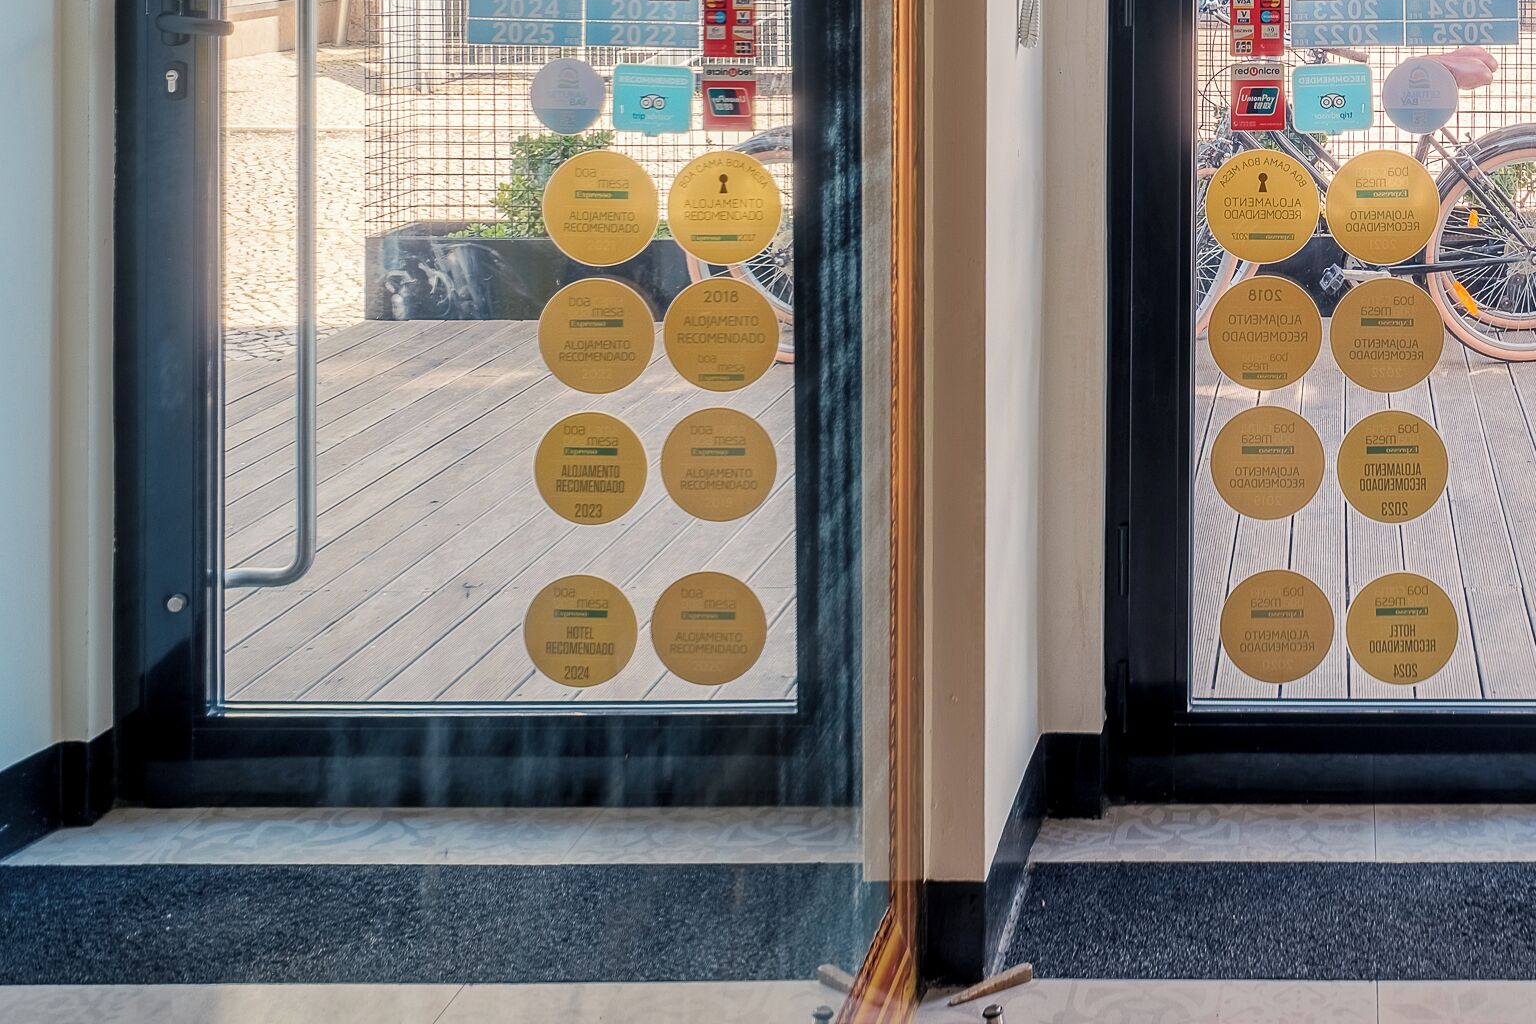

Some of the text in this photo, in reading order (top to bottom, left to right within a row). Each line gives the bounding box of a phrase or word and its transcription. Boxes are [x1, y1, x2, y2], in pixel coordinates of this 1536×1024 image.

[610, 0, 677, 20] 2023
[491, 21, 555, 44] 2025
[609, 25, 677, 45] 2022
[619, 75, 688, 85] RECOMMENDED
[1240, 94, 1276, 104] UnionPay
[684, 198, 763, 209] ALOJAMENTO
[568, 211, 635, 222] ALOJAMENTO
[684, 210, 763, 221] RECOMENDADO
[563, 223, 639, 233] RECOMENDADO
[703, 290, 739, 303] 2018
[683, 315, 758, 328] ALOJAMENTO
[677, 332, 766, 344] RECOMENDADO
[563, 339, 631, 351] ALOJAMENTO
[558, 351, 636, 362] RECOMENDADO
[560, 464, 620, 478] ALOJAMENTO
[685, 467, 752, 479] ALOJAMENTO
[555, 480, 625, 493] RECOMENDADO
[680, 479, 758, 491] RECOMENDADO
[574, 504, 603, 518] 2023
[566, 625, 594, 640] HOTEL
[674, 631, 743, 643] ALOJAMENTO
[545, 641, 615, 656] RECOMENDADO
[669, 643, 748, 655] RECOMENDADO
[564, 665, 590, 681] 2024
